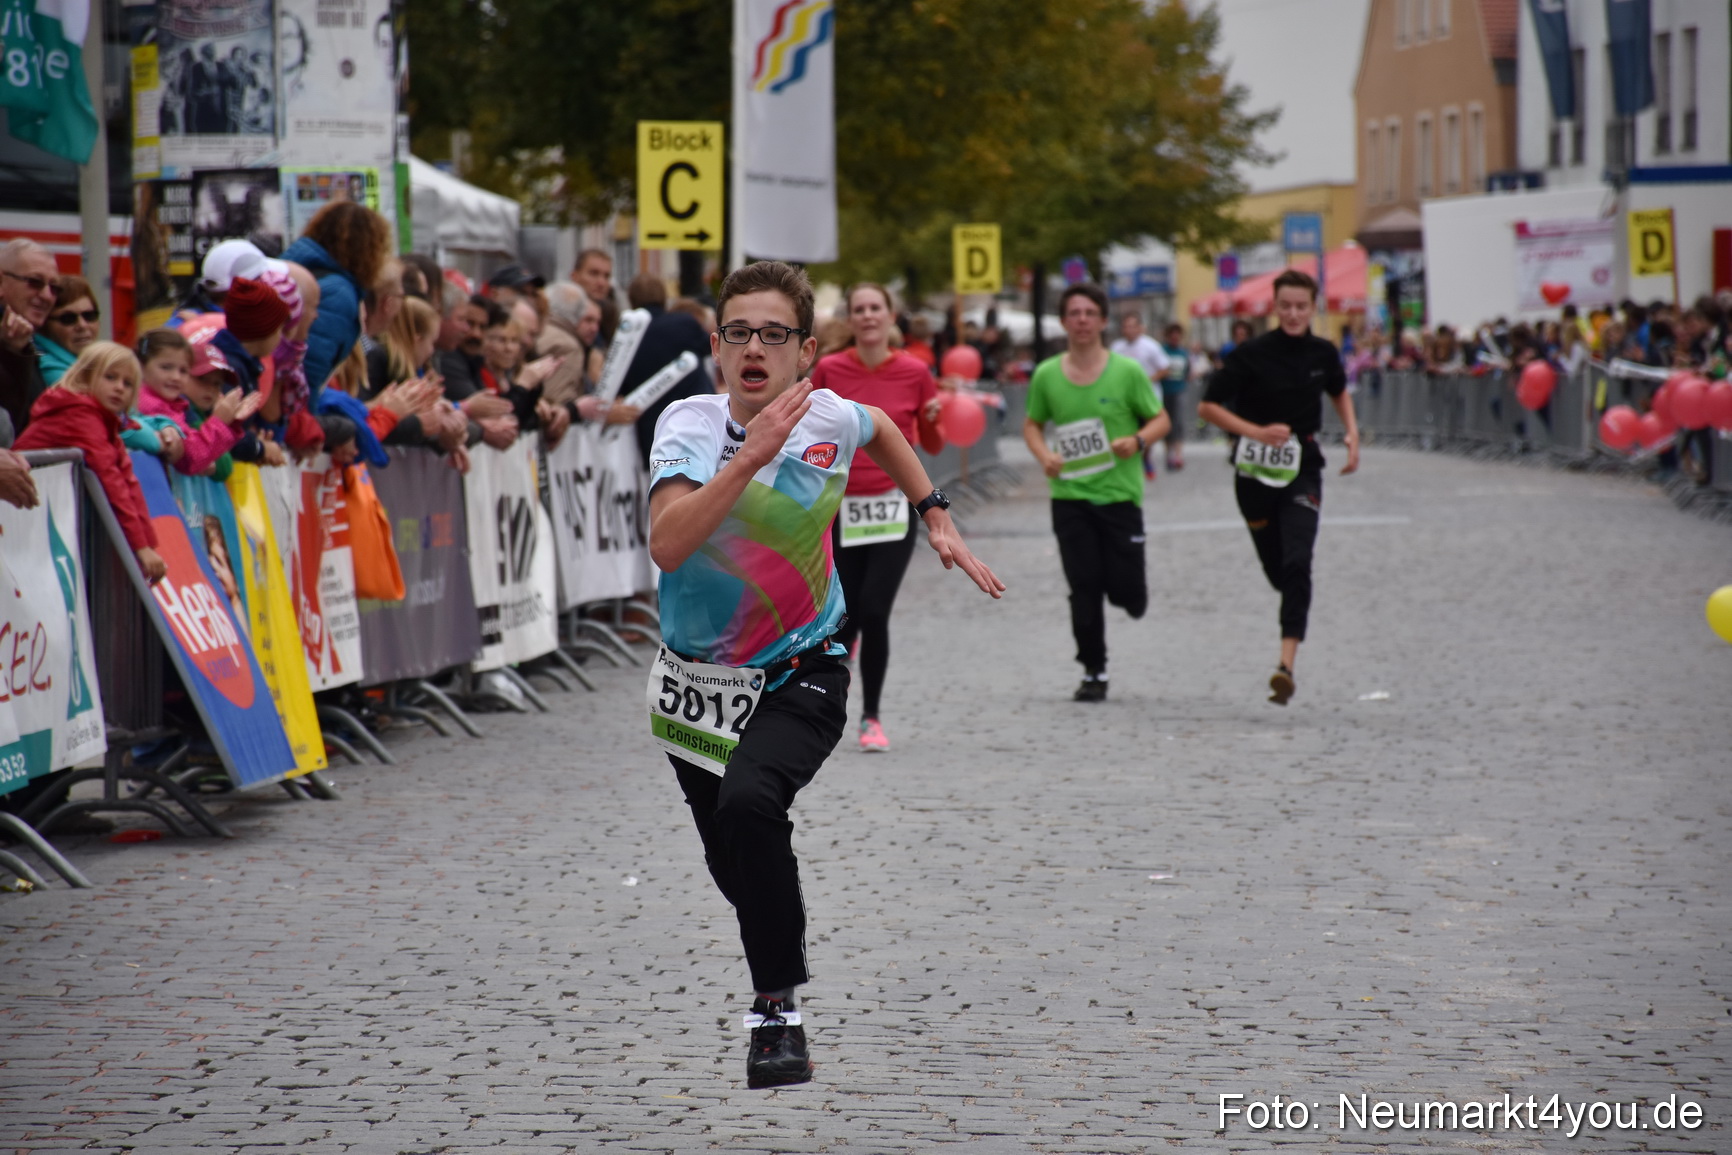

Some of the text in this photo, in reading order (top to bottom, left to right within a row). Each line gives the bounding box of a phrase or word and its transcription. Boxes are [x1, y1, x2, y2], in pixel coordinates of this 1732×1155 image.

[649, 128, 713, 151] Block
[660, 161, 700, 221] C
[1641, 230, 1665, 262] D
[967, 246, 990, 278] D
[1244, 441, 1295, 467] 5185
[848, 500, 900, 523] 5137
[686, 673, 745, 688] Neumarkt
[810, 684, 827, 694] JAKO
[658, 674, 754, 735] 5012
